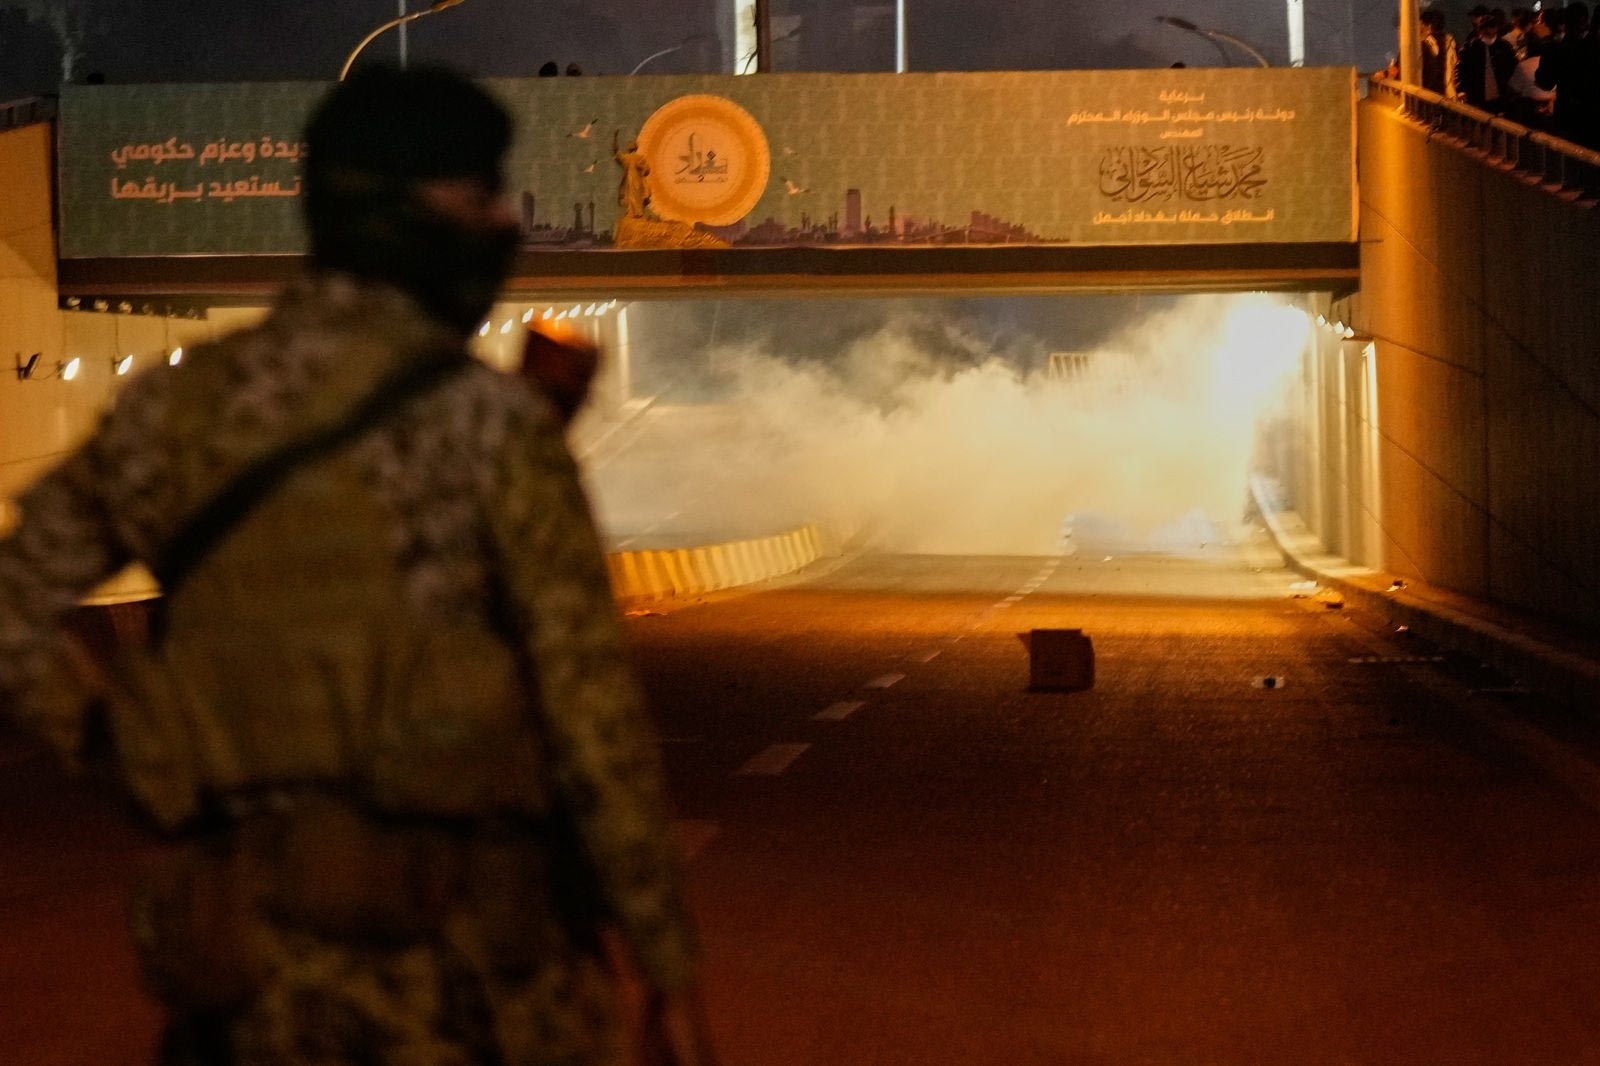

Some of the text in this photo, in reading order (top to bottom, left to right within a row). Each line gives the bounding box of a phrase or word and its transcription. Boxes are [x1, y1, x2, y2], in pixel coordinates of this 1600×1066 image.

[111, 136, 195, 169] حكومي
[199, 138, 257, 166] وعزم
[111, 176, 204, 204] بريقها
